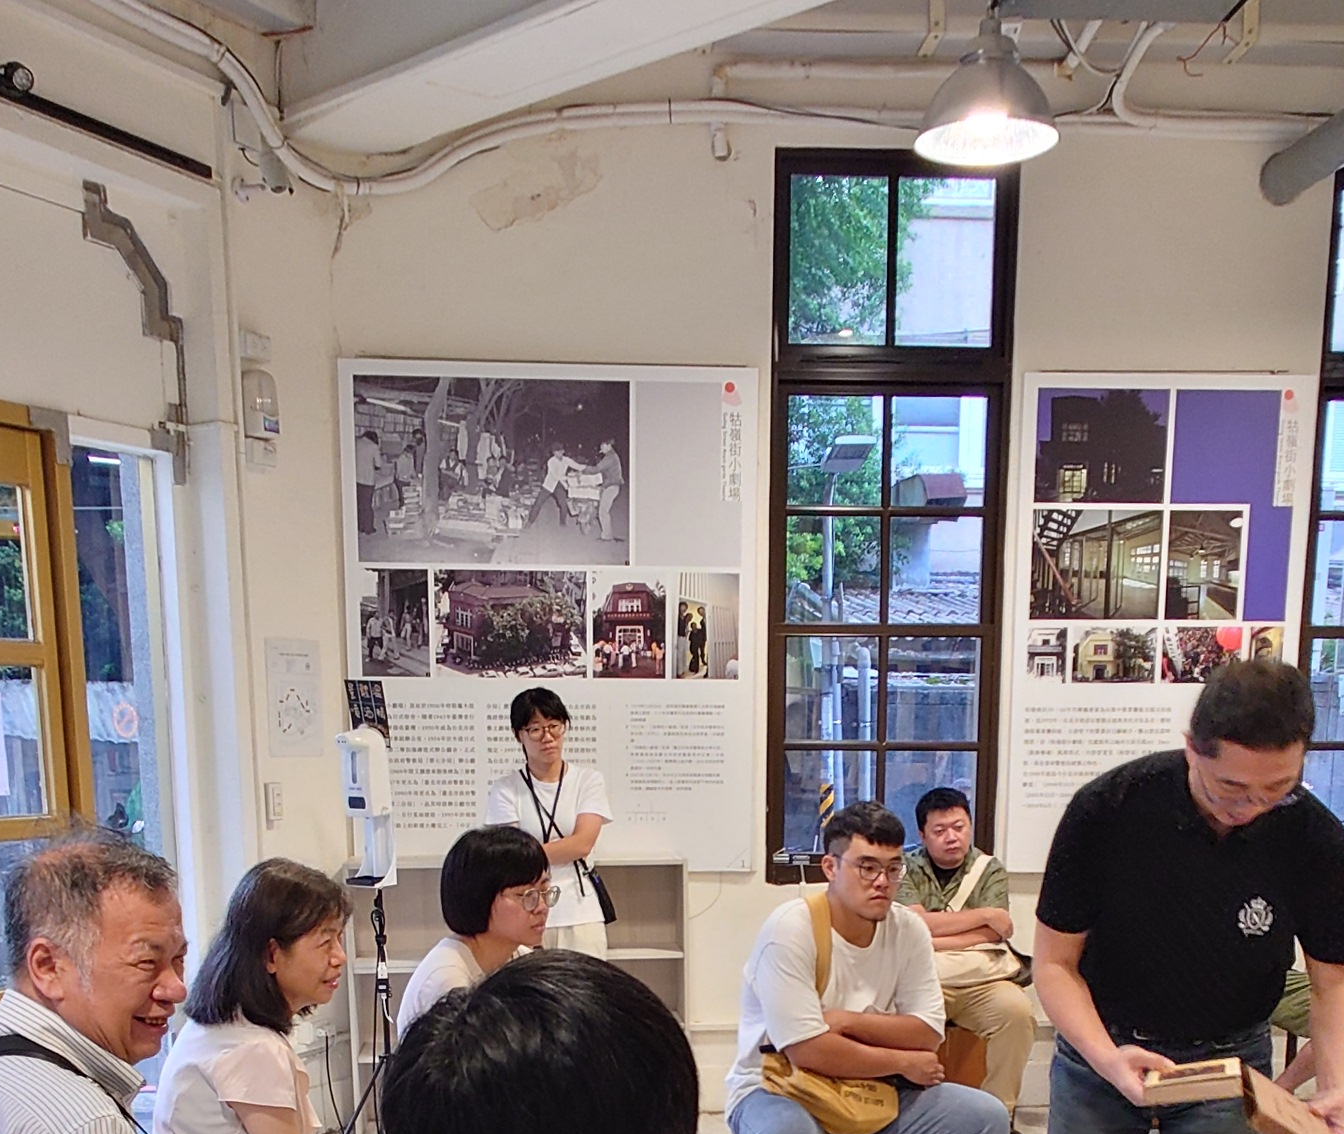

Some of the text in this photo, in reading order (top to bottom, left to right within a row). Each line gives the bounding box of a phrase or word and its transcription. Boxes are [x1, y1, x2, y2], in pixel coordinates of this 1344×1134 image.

[728, 412, 742, 501] 牯嶺街小劇場
